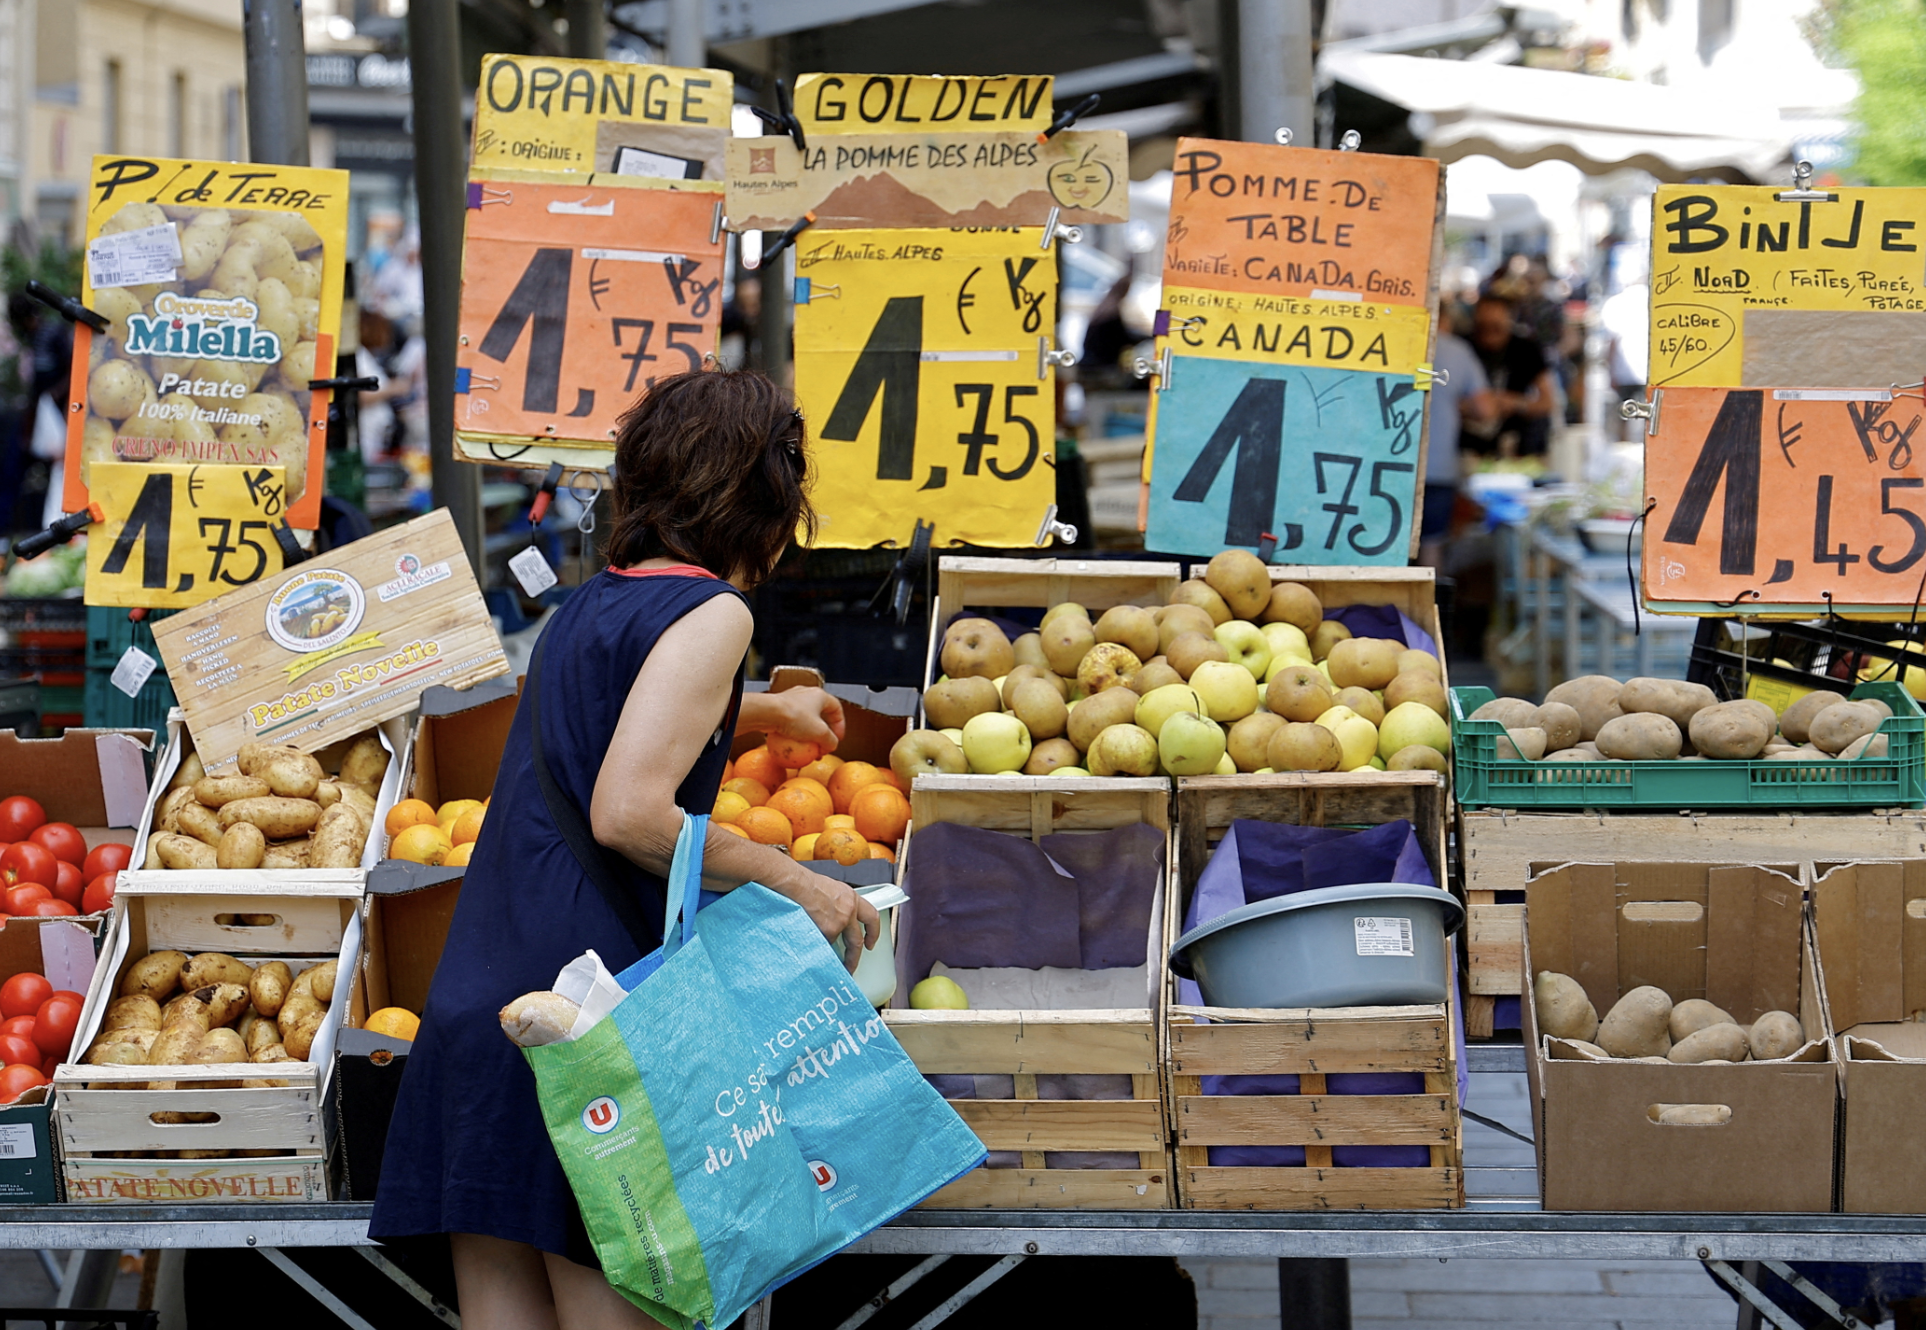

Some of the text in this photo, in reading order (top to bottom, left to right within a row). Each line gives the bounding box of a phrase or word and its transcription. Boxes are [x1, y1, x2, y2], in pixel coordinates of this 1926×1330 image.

[487, 59, 712, 124] ORANGE
[815, 76, 1050, 123] GOLDEN
[803, 141, 1039, 172] LA POMME DES ALPES
[174, 168, 219, 204] de
[222, 171, 333, 211] TERRE
[733, 180, 798, 190] Hautes Alpes
[1226, 213, 1355, 247] TABLE
[892, 245, 944, 261] ALPES
[663, 255, 720, 318] Kg
[1004, 257, 1046, 333] Kg
[158, 295, 256, 320] Oroverde
[128, 316, 278, 361] Milella
[1181, 316, 1389, 366] CANADA
[158, 372, 247, 400] Patate
[819, 295, 1040, 492] 1,75
[137, 401, 262, 426] 100% Italiane
[1376, 377, 1421, 455] Kg
[111, 434, 279, 465] CRENO IMPEX SAS
[1846, 401, 1923, 470] Kg
[1172, 377, 1415, 557] 1,75
[243, 467, 284, 516] Kg
[1663, 389, 1926, 586] 1,45
[100, 473, 268, 594] 1,75
[272, 571, 346, 606] Buone Patate
[406, 565, 442, 584] RACALE
[180, 634, 239, 663] HANDVERLESEN
[185, 623, 222, 643] RACCOLTE
[198, 631, 220, 644] MANO
[303, 628, 347, 649] DEL SALENTO
[201, 651, 224, 665] HAND
[201, 657, 230, 673] PICKED
[207, 673, 239, 690] LA MAIN
[250, 678, 337, 727] Patate
[338, 638, 440, 692] Novelle
[273, 730, 299, 745] POMMES
[299, 725, 308, 734] DE
[438, 667, 454, 678] NEW
[453, 656, 484, 672] POTATOES
[715, 1086, 747, 1117] Ce
[764, 980, 858, 1059] rempli
[704, 1145, 733, 1175] de
[786, 1015, 881, 1087] attentio
[588, 1102, 612, 1126] U
[584, 1125, 640, 1156] Commerçants
[594, 1136, 637, 1161] autrement
[168, 1175, 304, 1199] NOVELLE
[618, 1174, 665, 1302] de matières recyclées
[644, 1209, 674, 1286] magasins-u.com
